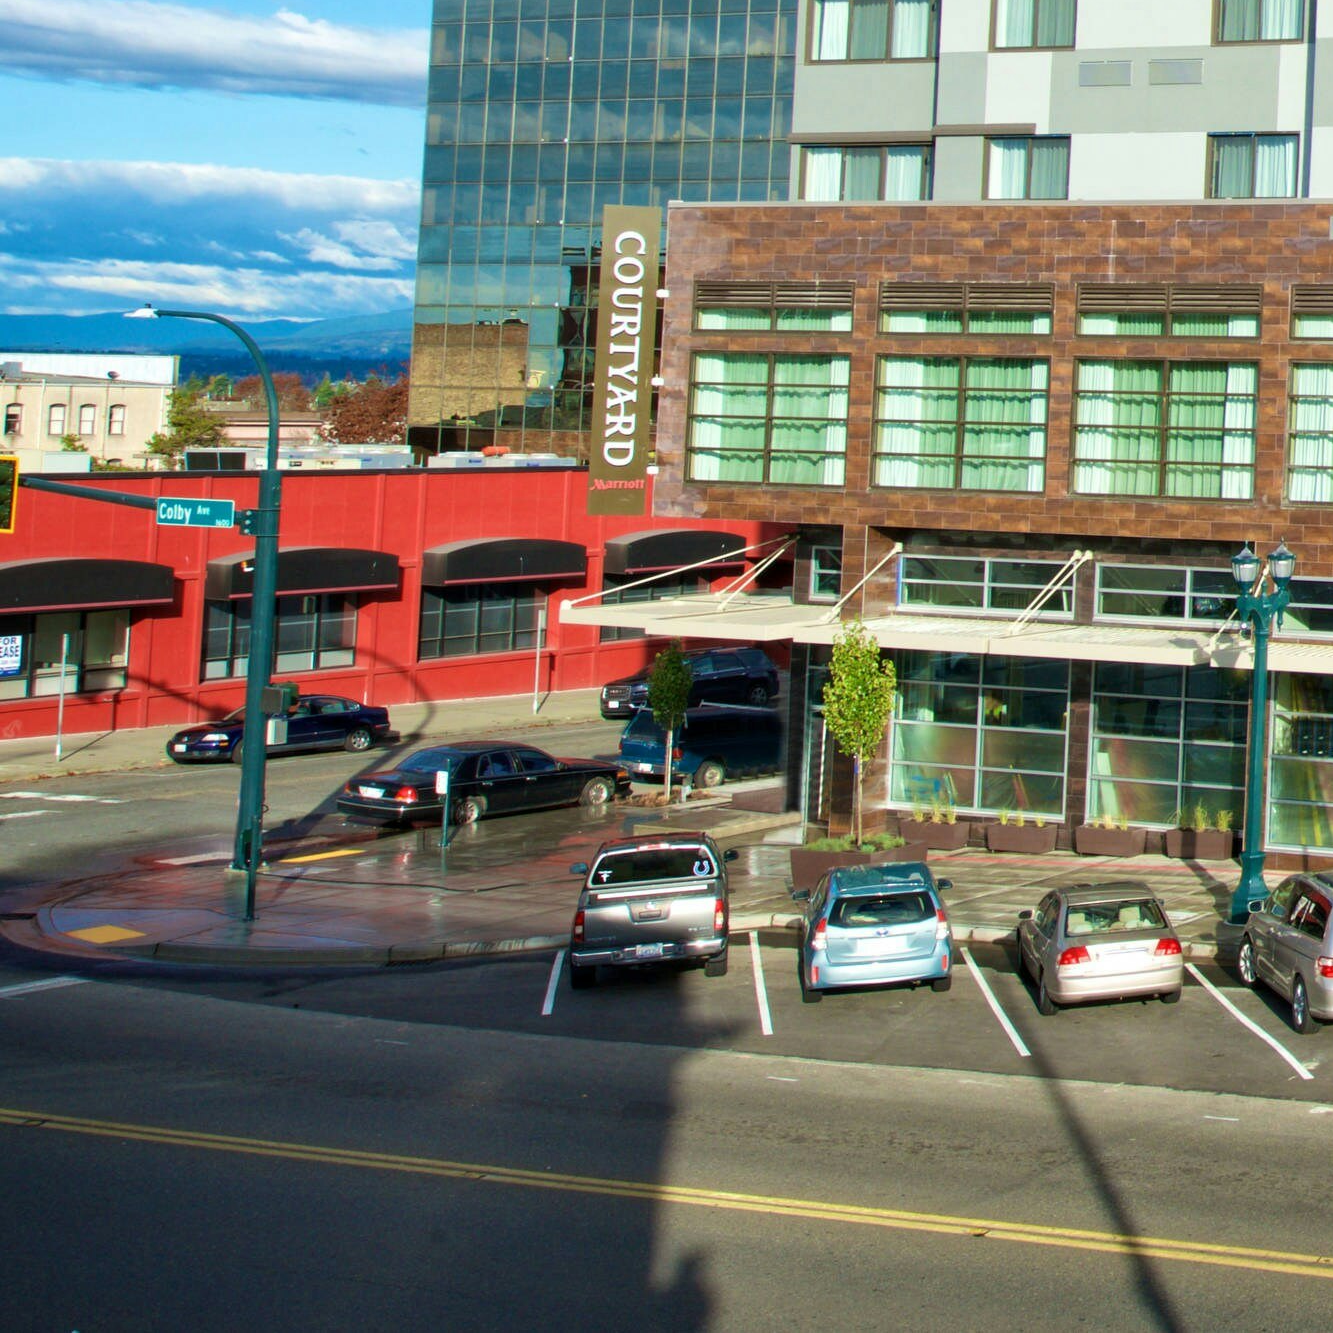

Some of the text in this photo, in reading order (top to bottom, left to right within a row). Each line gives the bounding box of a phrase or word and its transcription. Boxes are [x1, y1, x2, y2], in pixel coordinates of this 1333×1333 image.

[603, 230, 646, 467] COURTYARD
[590, 478, 645, 491] Marriott
[159, 502, 210, 525] Colby Ave
[0, 645, 20, 658] EASE
